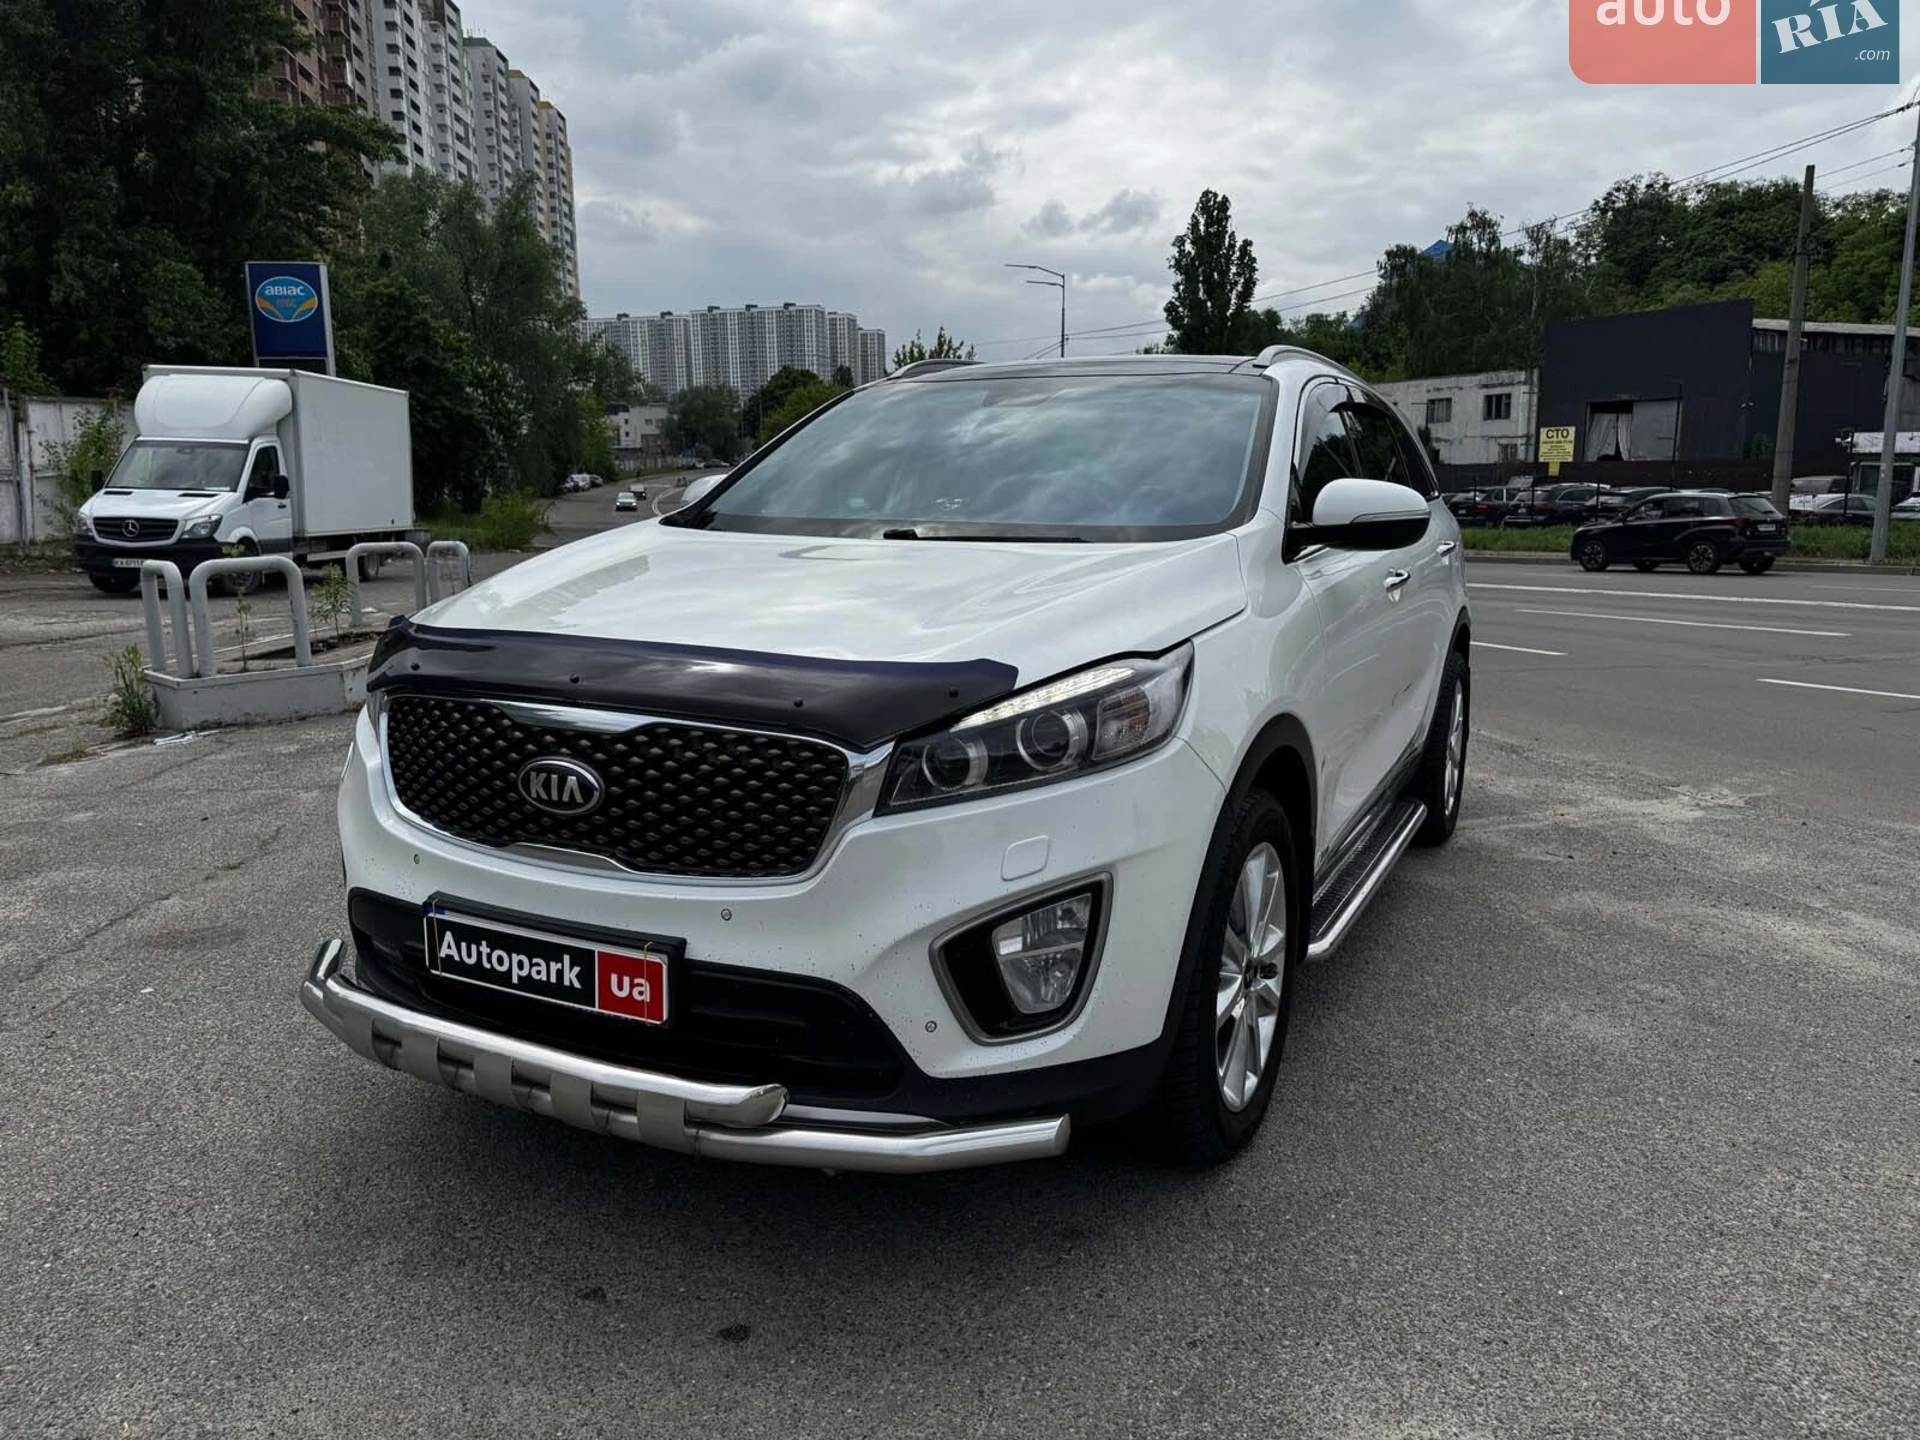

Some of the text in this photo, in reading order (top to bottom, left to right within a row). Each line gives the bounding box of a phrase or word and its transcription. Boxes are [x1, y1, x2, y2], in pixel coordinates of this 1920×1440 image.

[529, 771, 584, 804] KIA
[439, 931, 651, 1002] Autopark ua
